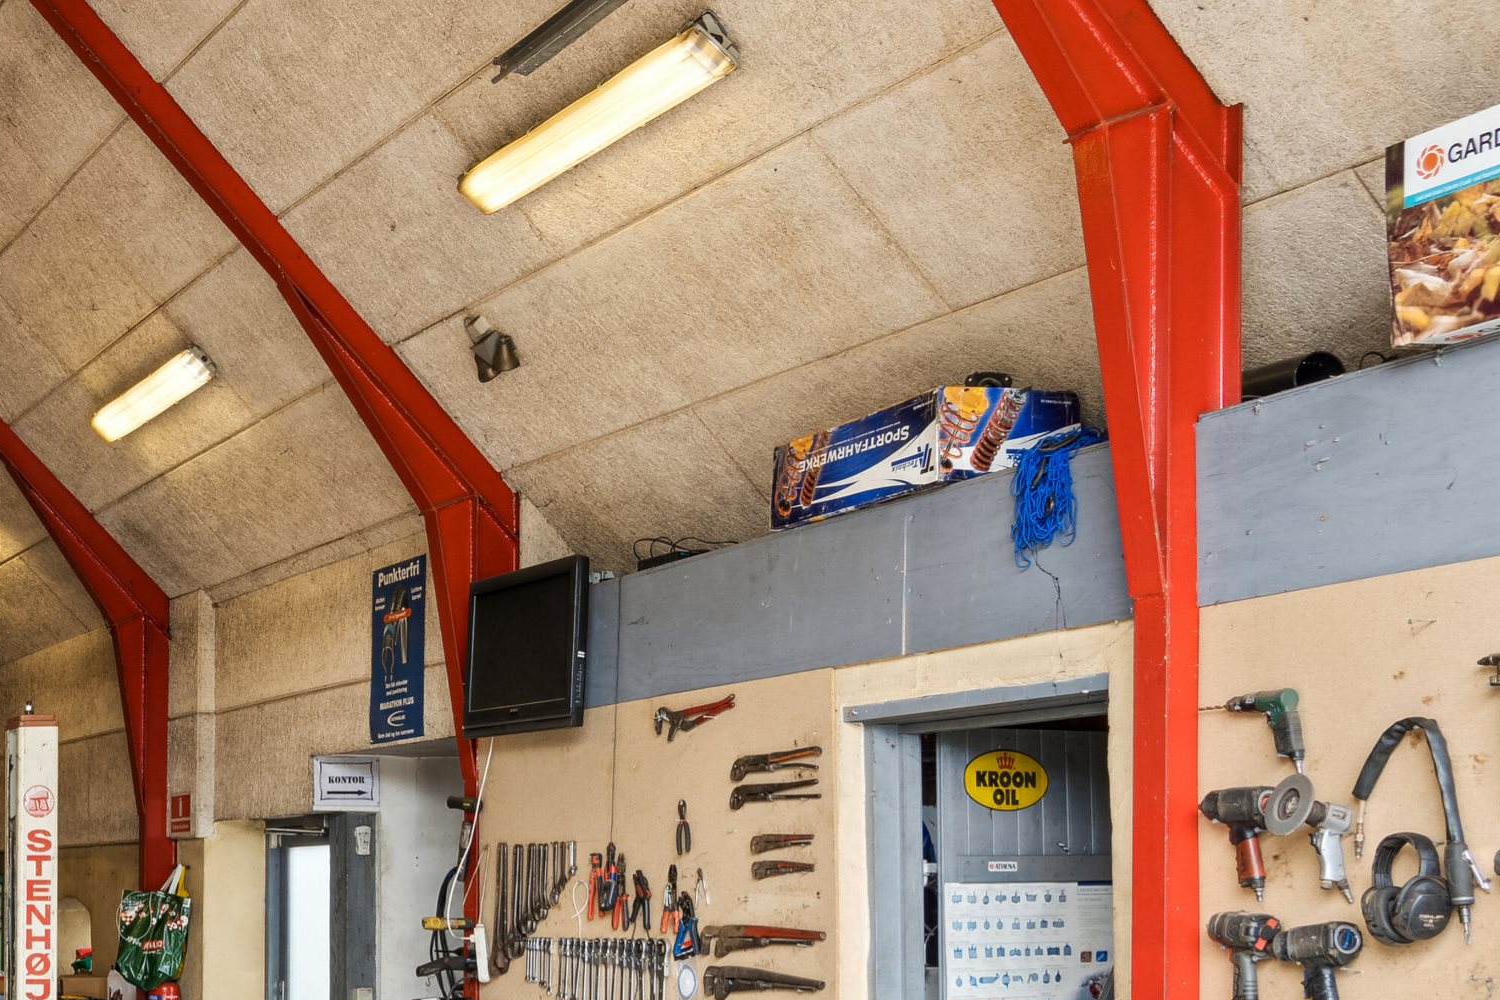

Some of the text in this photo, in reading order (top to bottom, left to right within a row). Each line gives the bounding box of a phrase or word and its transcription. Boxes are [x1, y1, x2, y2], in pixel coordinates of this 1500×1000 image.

[796, 425, 910, 472] SPORTFAHRWERKE
[377, 560, 420, 588] Punkterfri
[402, 696, 415, 707] PLUS
[328, 775, 365, 785] KONTOR
[975, 769, 1037, 789] KROON
[992, 788, 1019, 806] OIL
[995, 862, 1016, 871] ATHENA
